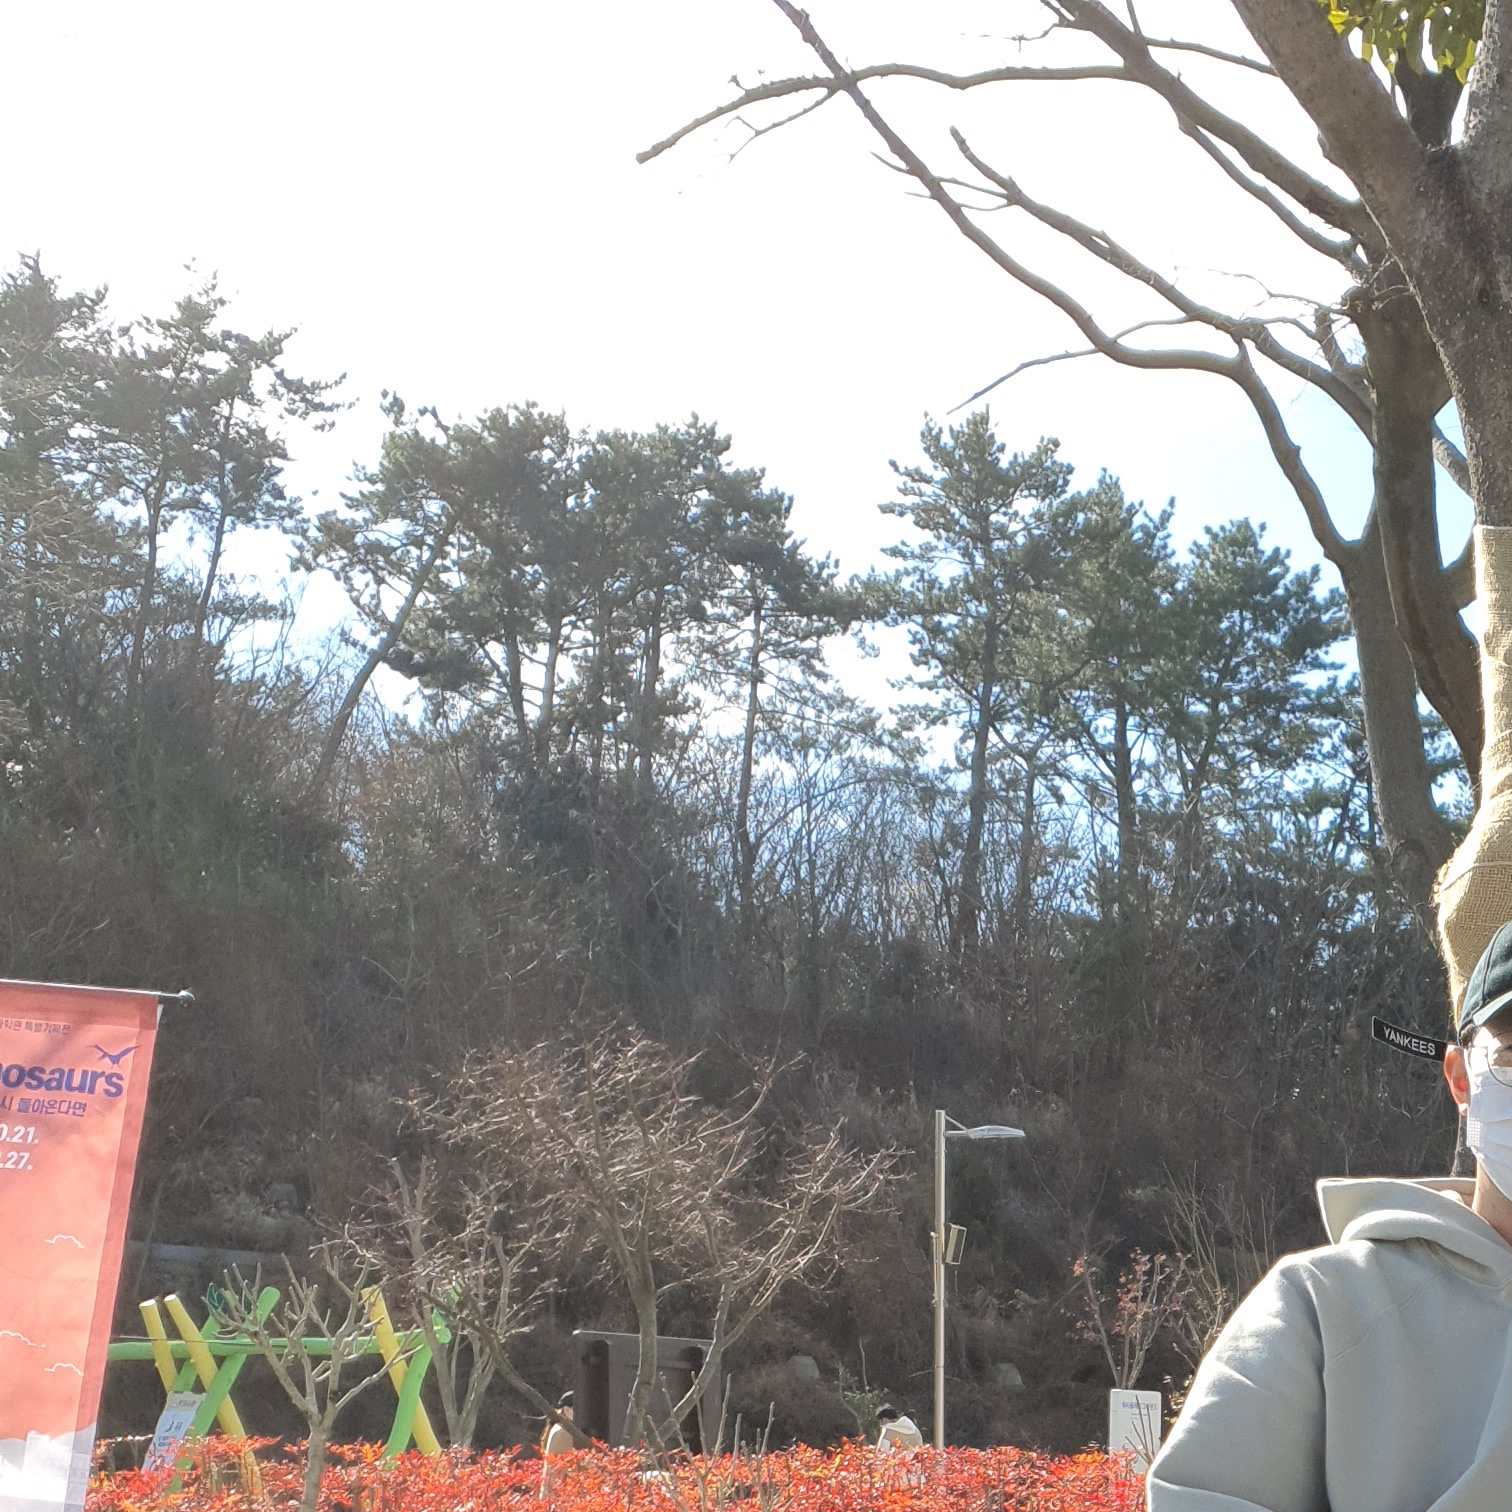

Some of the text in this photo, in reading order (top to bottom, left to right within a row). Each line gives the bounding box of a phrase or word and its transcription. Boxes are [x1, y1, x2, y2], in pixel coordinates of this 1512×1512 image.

[1383, 1025, 1437, 1057] YANKEES
[0, 1062, 124, 1098] osaurs
[17, 1097, 88, 1118] 돌아온다면
